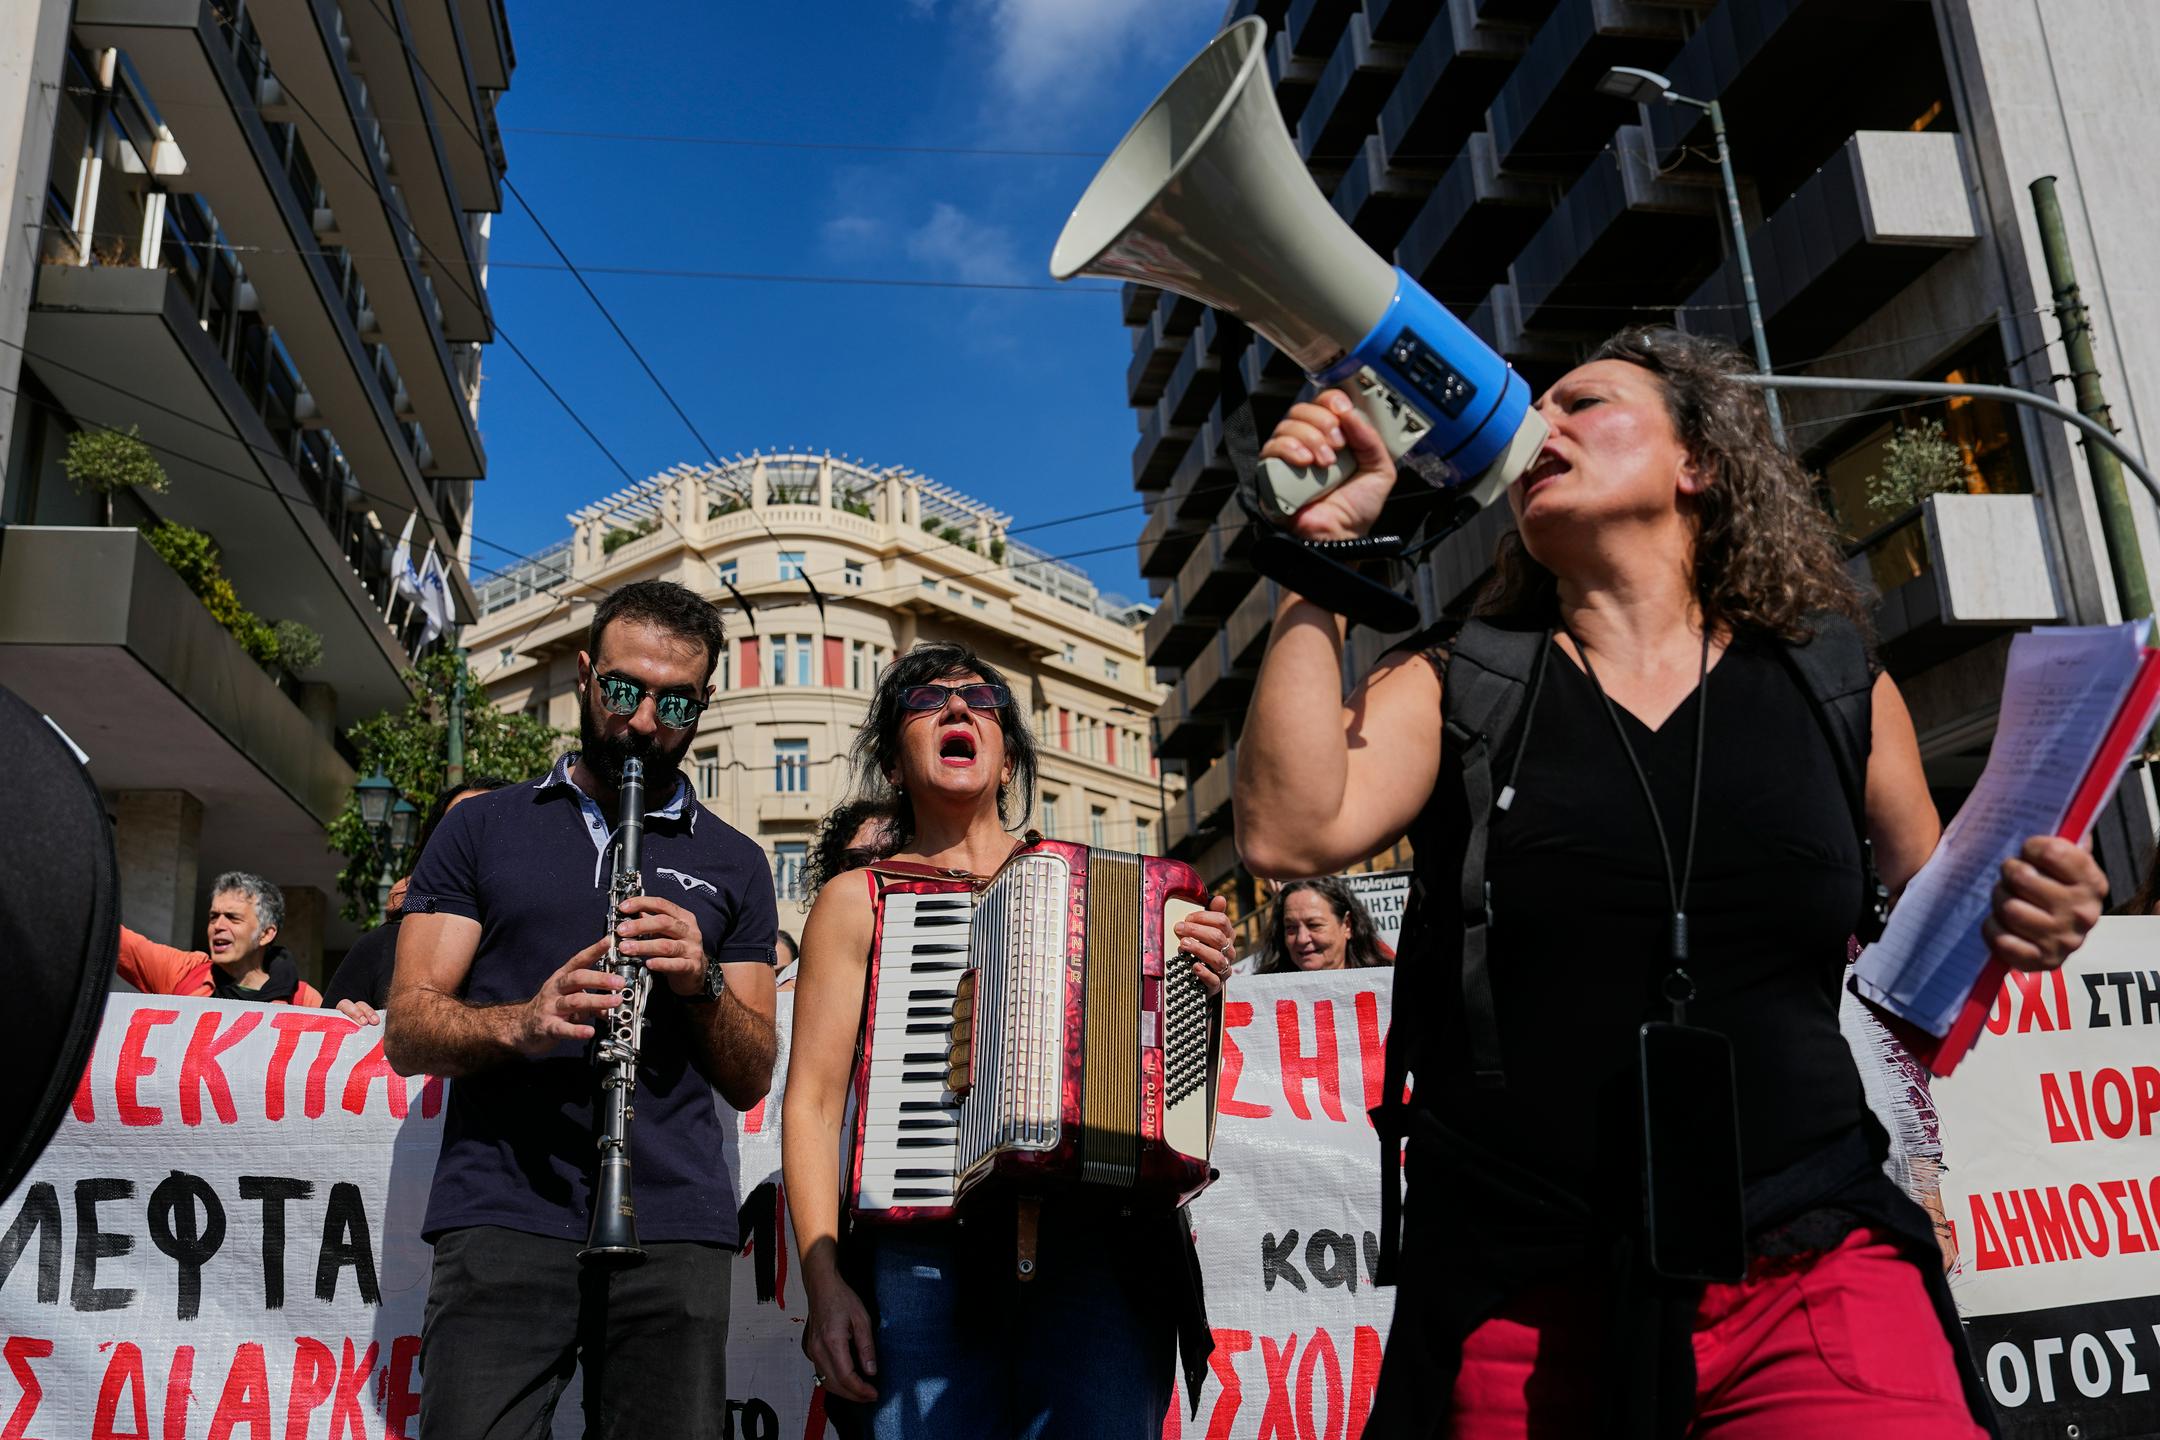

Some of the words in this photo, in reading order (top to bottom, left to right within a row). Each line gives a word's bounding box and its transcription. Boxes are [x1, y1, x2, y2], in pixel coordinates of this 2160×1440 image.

[1070, 887, 1084, 984] HOHNER
[1364, 895, 1404, 913] ΗΣΗ
[0, 1169, 383, 1321] ΛΕΦΤΑ
[1968, 1175, 2160, 1272] ΔΗΜΟΣΙ
